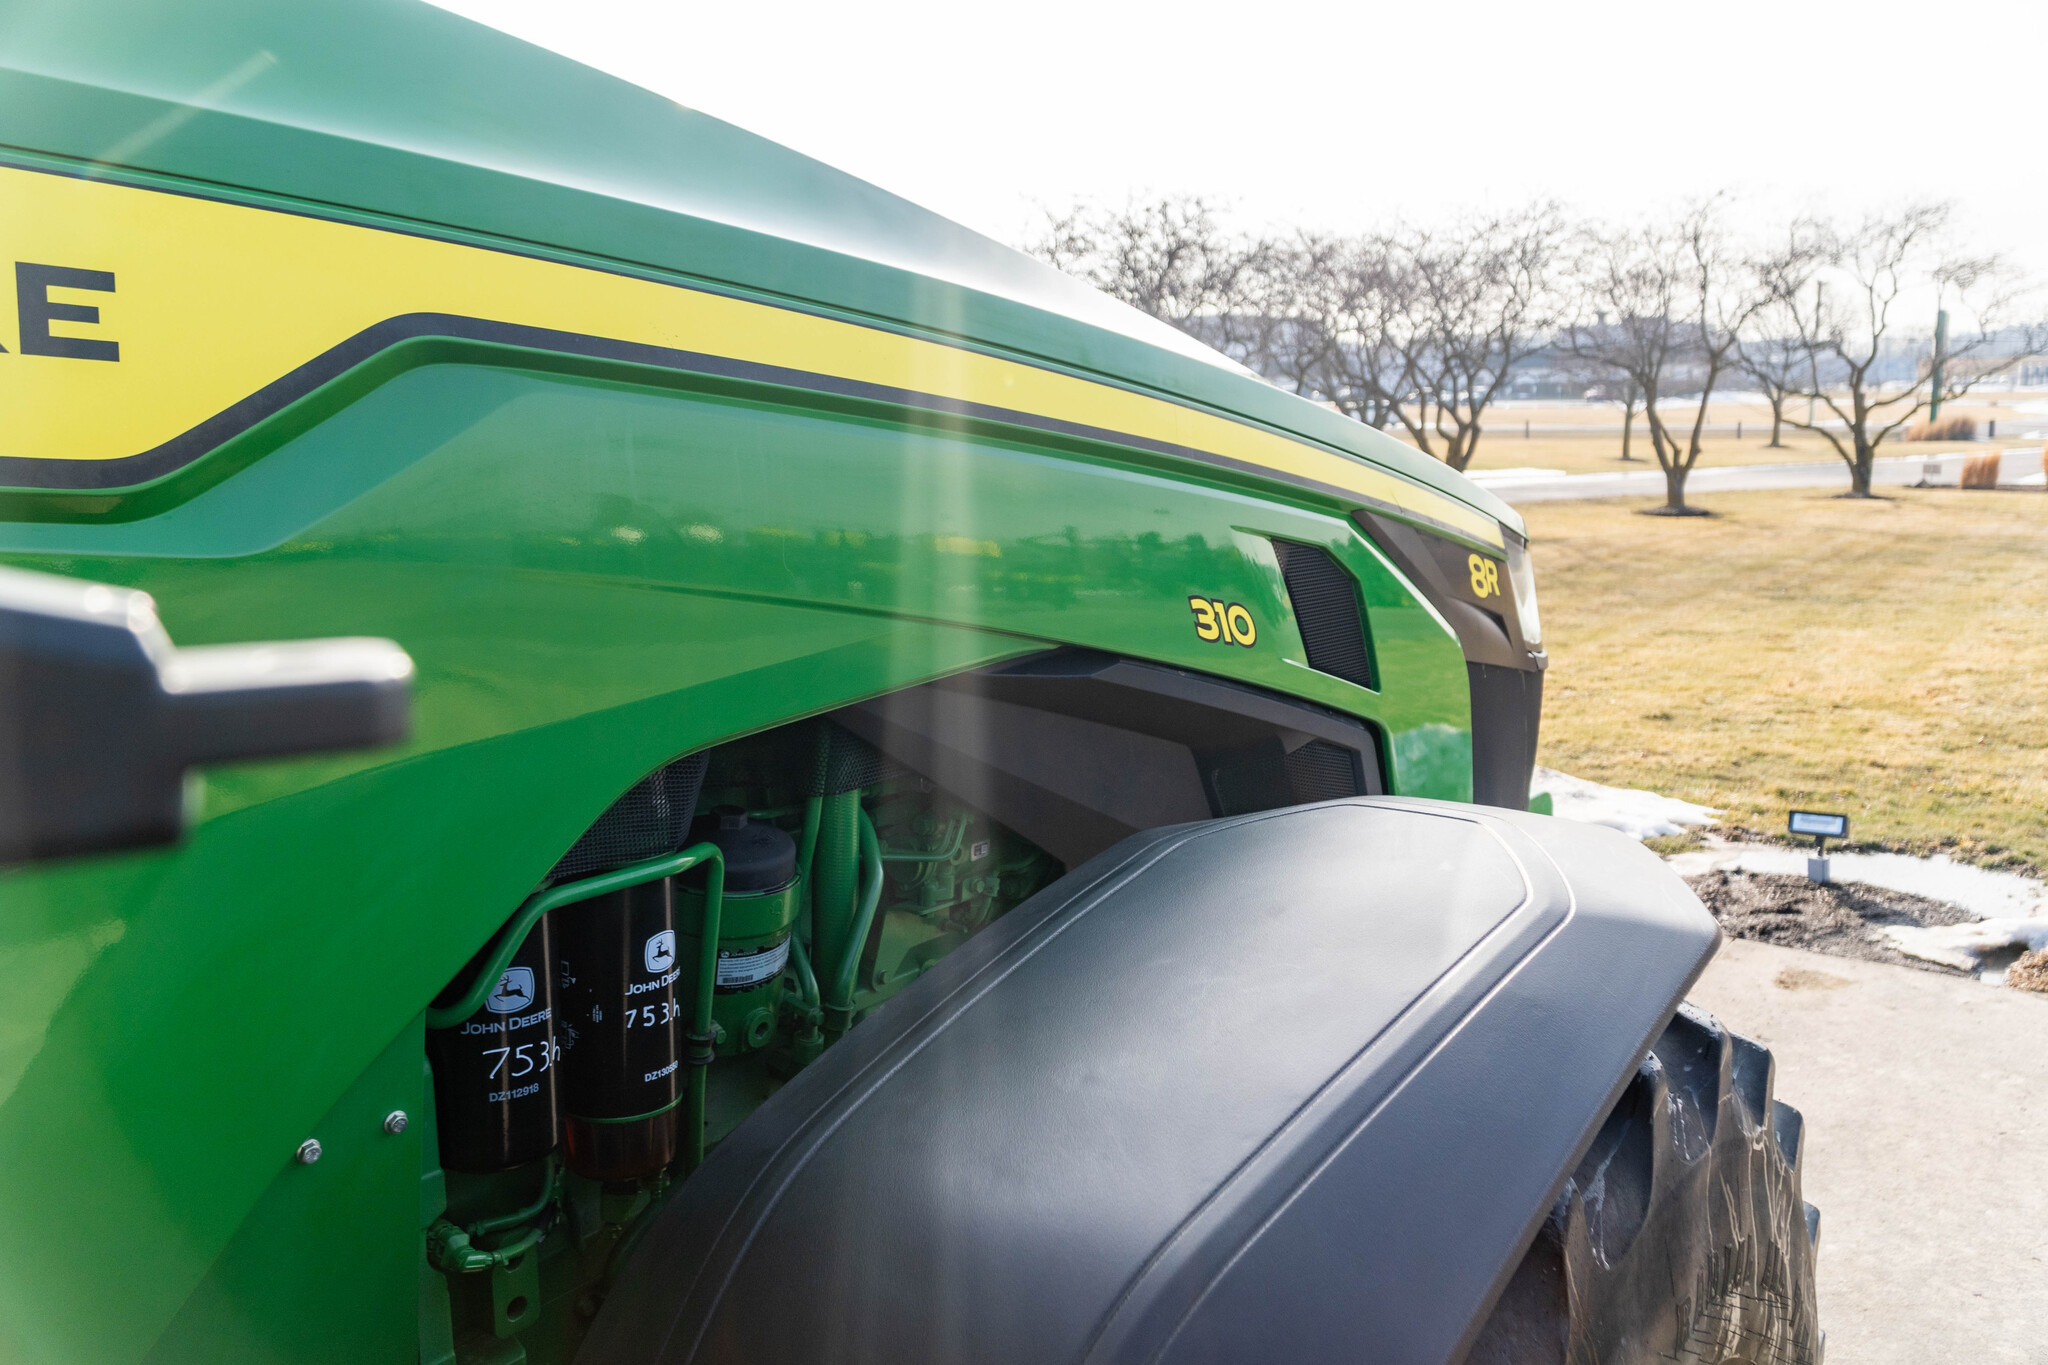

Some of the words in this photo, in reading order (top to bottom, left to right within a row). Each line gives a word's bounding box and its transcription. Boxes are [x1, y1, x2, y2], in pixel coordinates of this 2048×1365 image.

[0, 261, 120, 362] E
[1468, 553, 1500, 599] 8R
[1188, 595, 1257, 648] 310
[624, 979, 660, 996] JOHN
[460, 1022, 506, 1035] JOHN
[508, 1007, 552, 1031] DEERE
[489, 1082, 540, 1102] DZ112918
